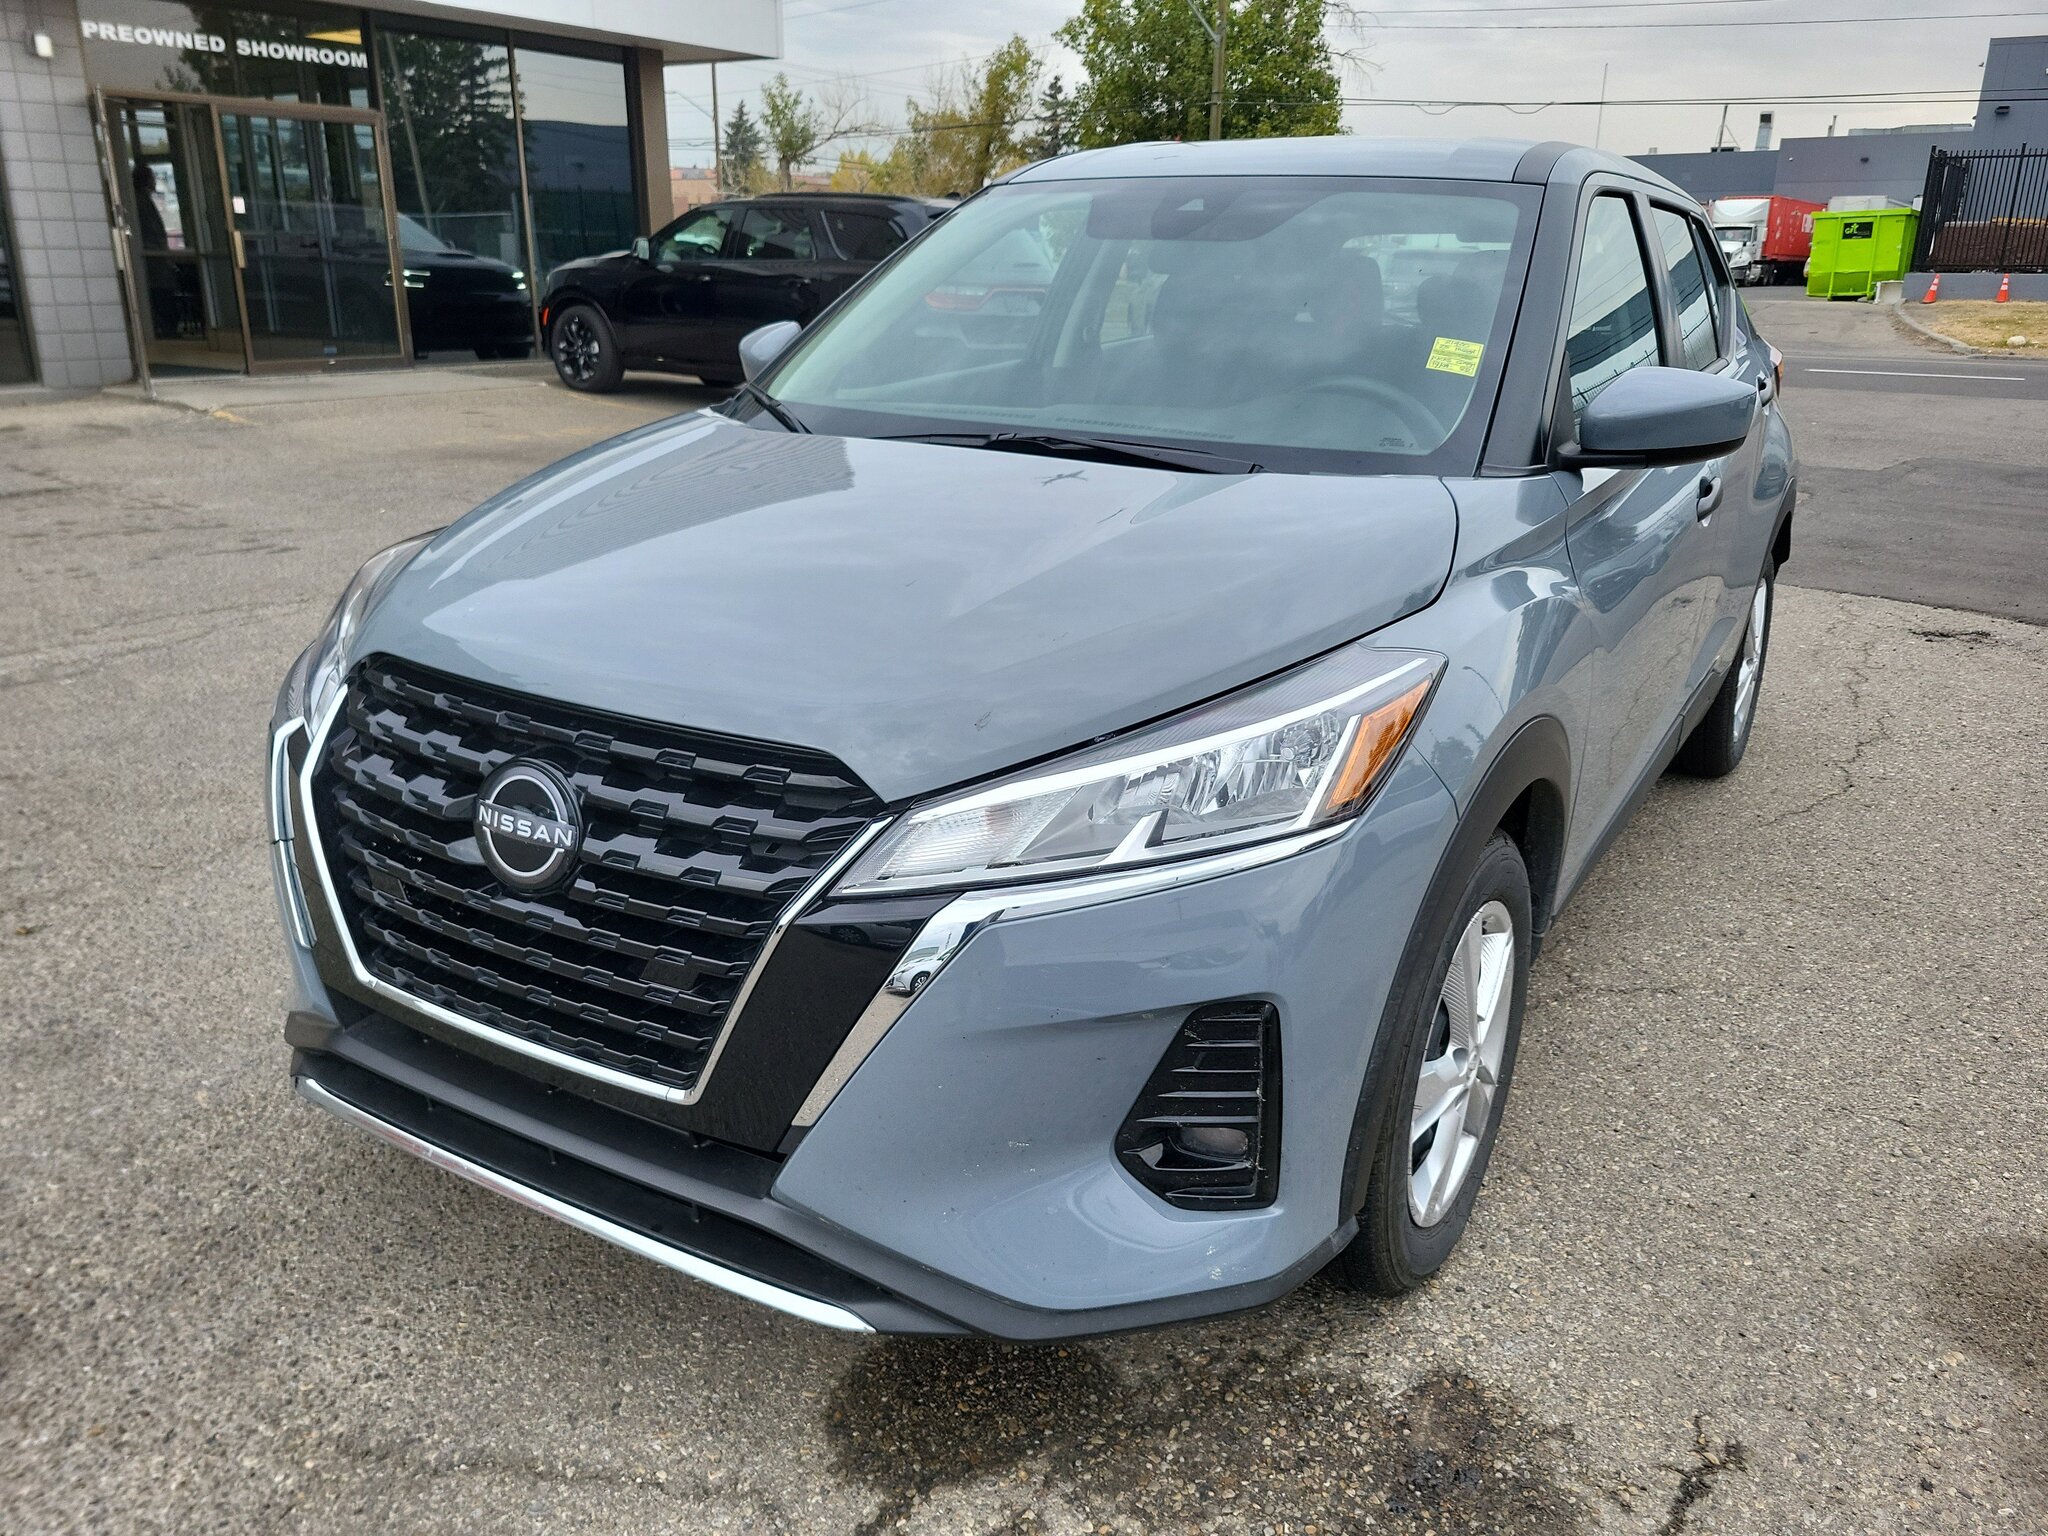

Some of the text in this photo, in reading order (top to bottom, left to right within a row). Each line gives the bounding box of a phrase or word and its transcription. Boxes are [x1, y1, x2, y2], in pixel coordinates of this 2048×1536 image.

[81, 20, 368, 68] PREOWNED SHOWROOM
[479, 805, 573, 847] NISSAN
